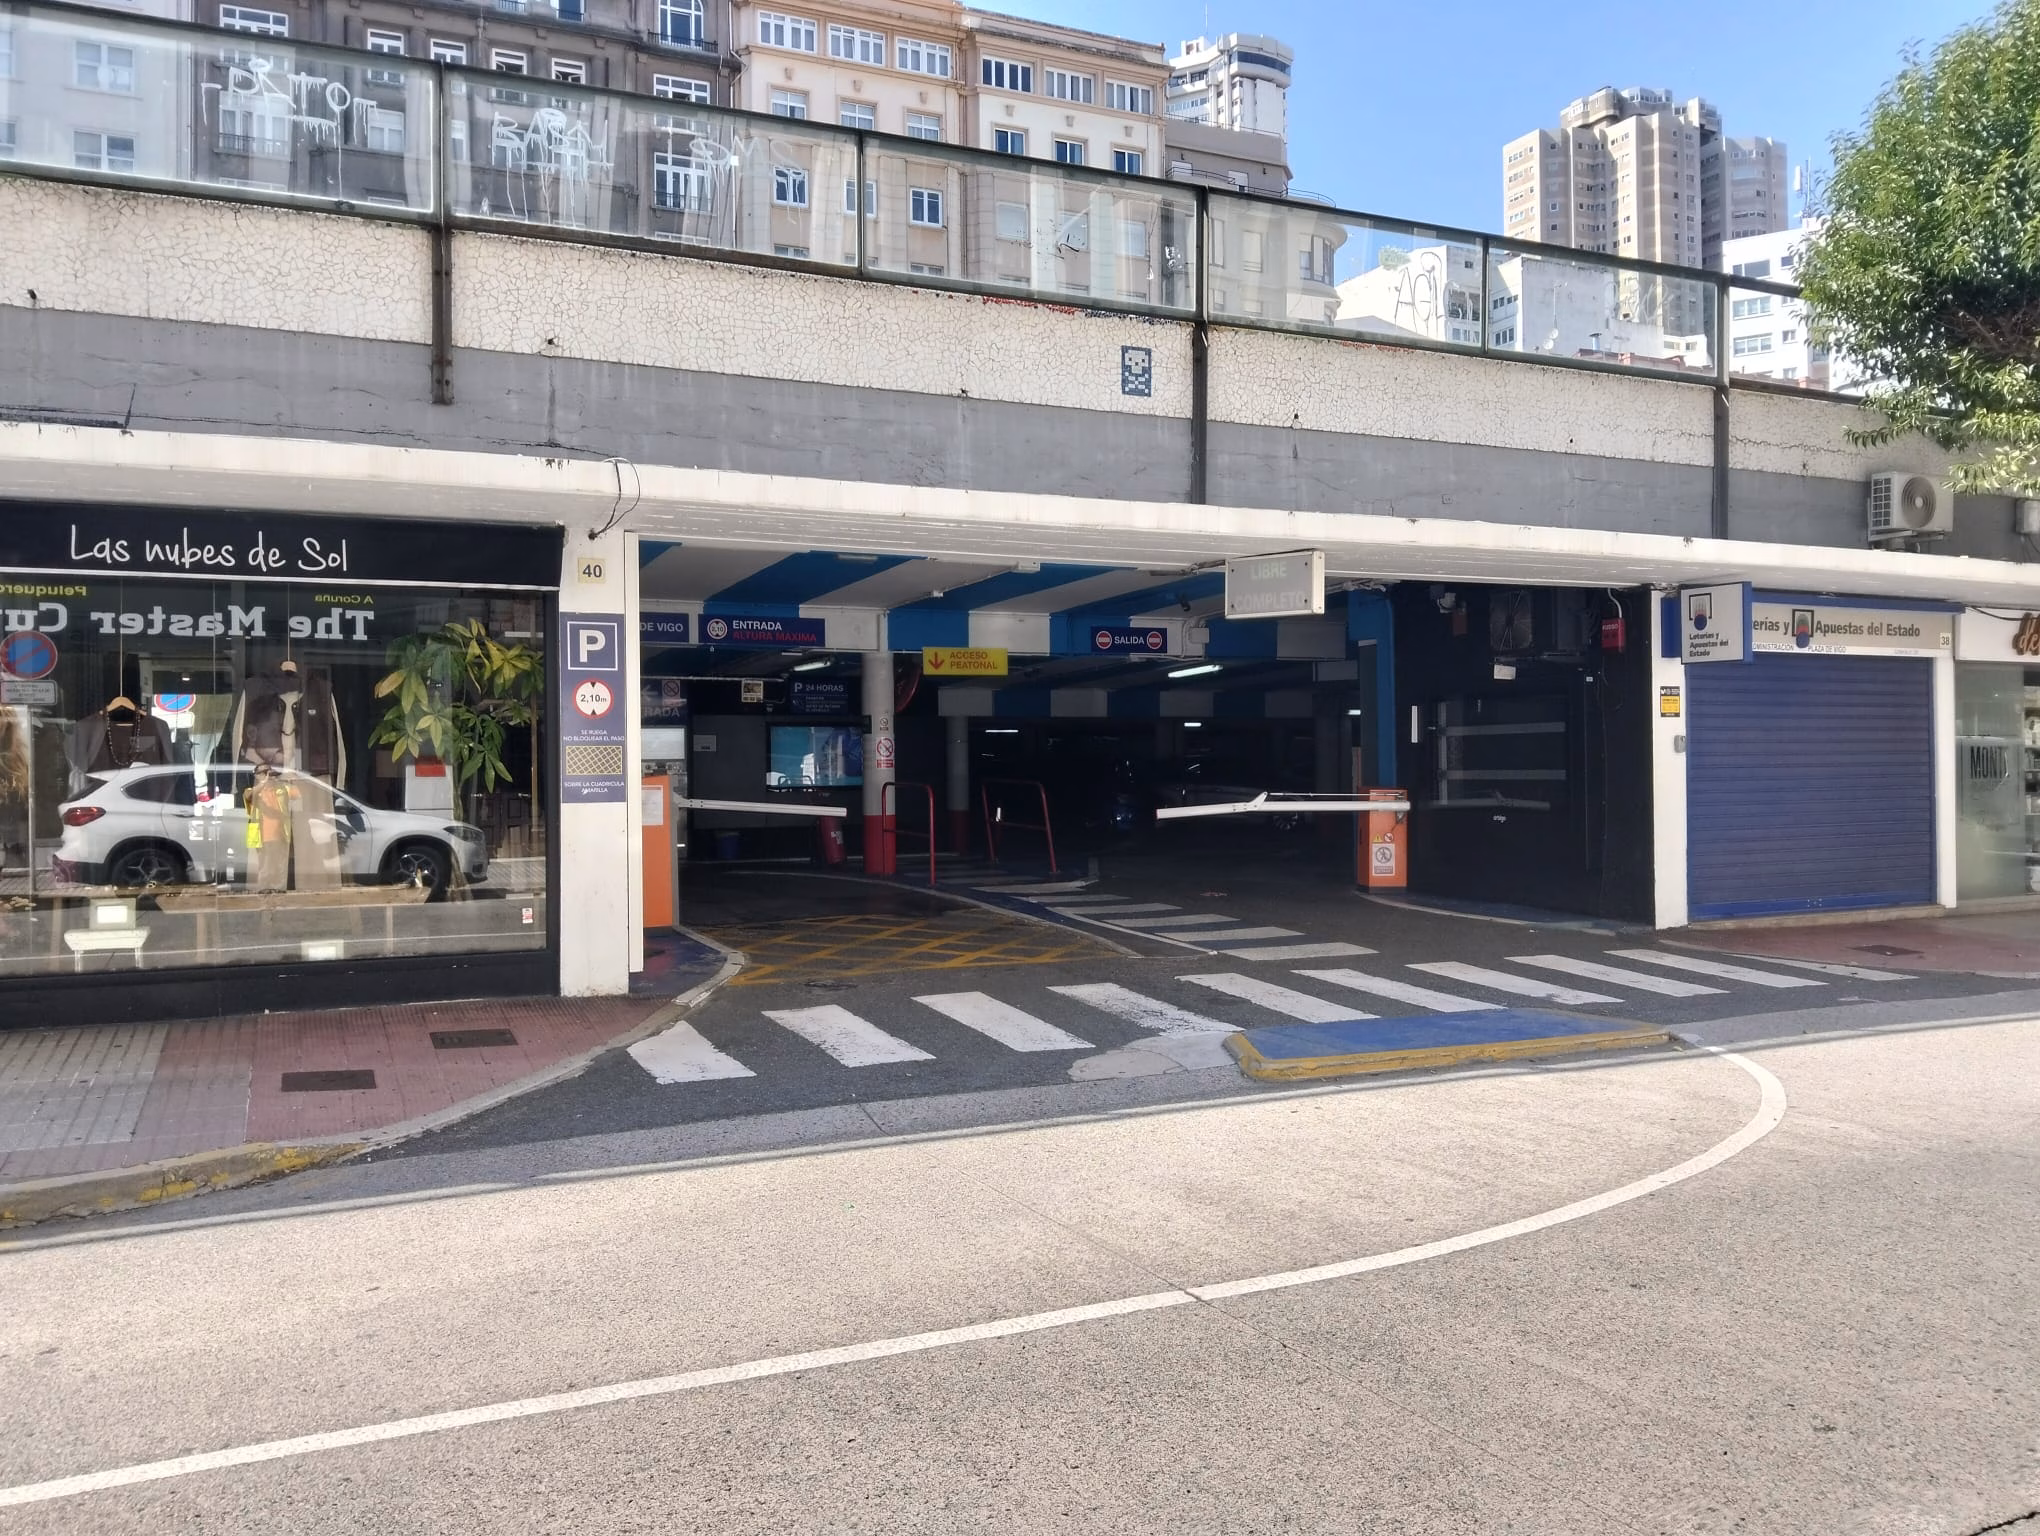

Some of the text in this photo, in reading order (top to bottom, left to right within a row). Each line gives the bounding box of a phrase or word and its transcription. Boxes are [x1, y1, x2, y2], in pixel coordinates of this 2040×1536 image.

[70, 524, 348, 572] Las nubes de Sol
[582, 563, 603, 578] 40
[1251, 560, 1288, 581] LIBRE
[656, 622, 684, 632] VIGO
[732, 620, 782, 631] ENTRADA
[1783, 621, 1790, 635] y
[1815, 620, 1864, 637] Apuestas
[1867, 621, 1883, 636] del
[1886, 623, 1920, 637] Estado
[733, 631, 817, 642] ALTURA MAXIMA
[1114, 636, 1144, 645] SALIDA
[1941, 635, 1950, 646] 38
[579, 629, 606, 663] P
[1689, 641, 1717, 650] Apuestas
[950, 651, 988, 660] ACCESO
[1689, 649, 1711, 657] Estado
[950, 661, 998, 670] PEATONAL
[794, 682, 802, 692] P
